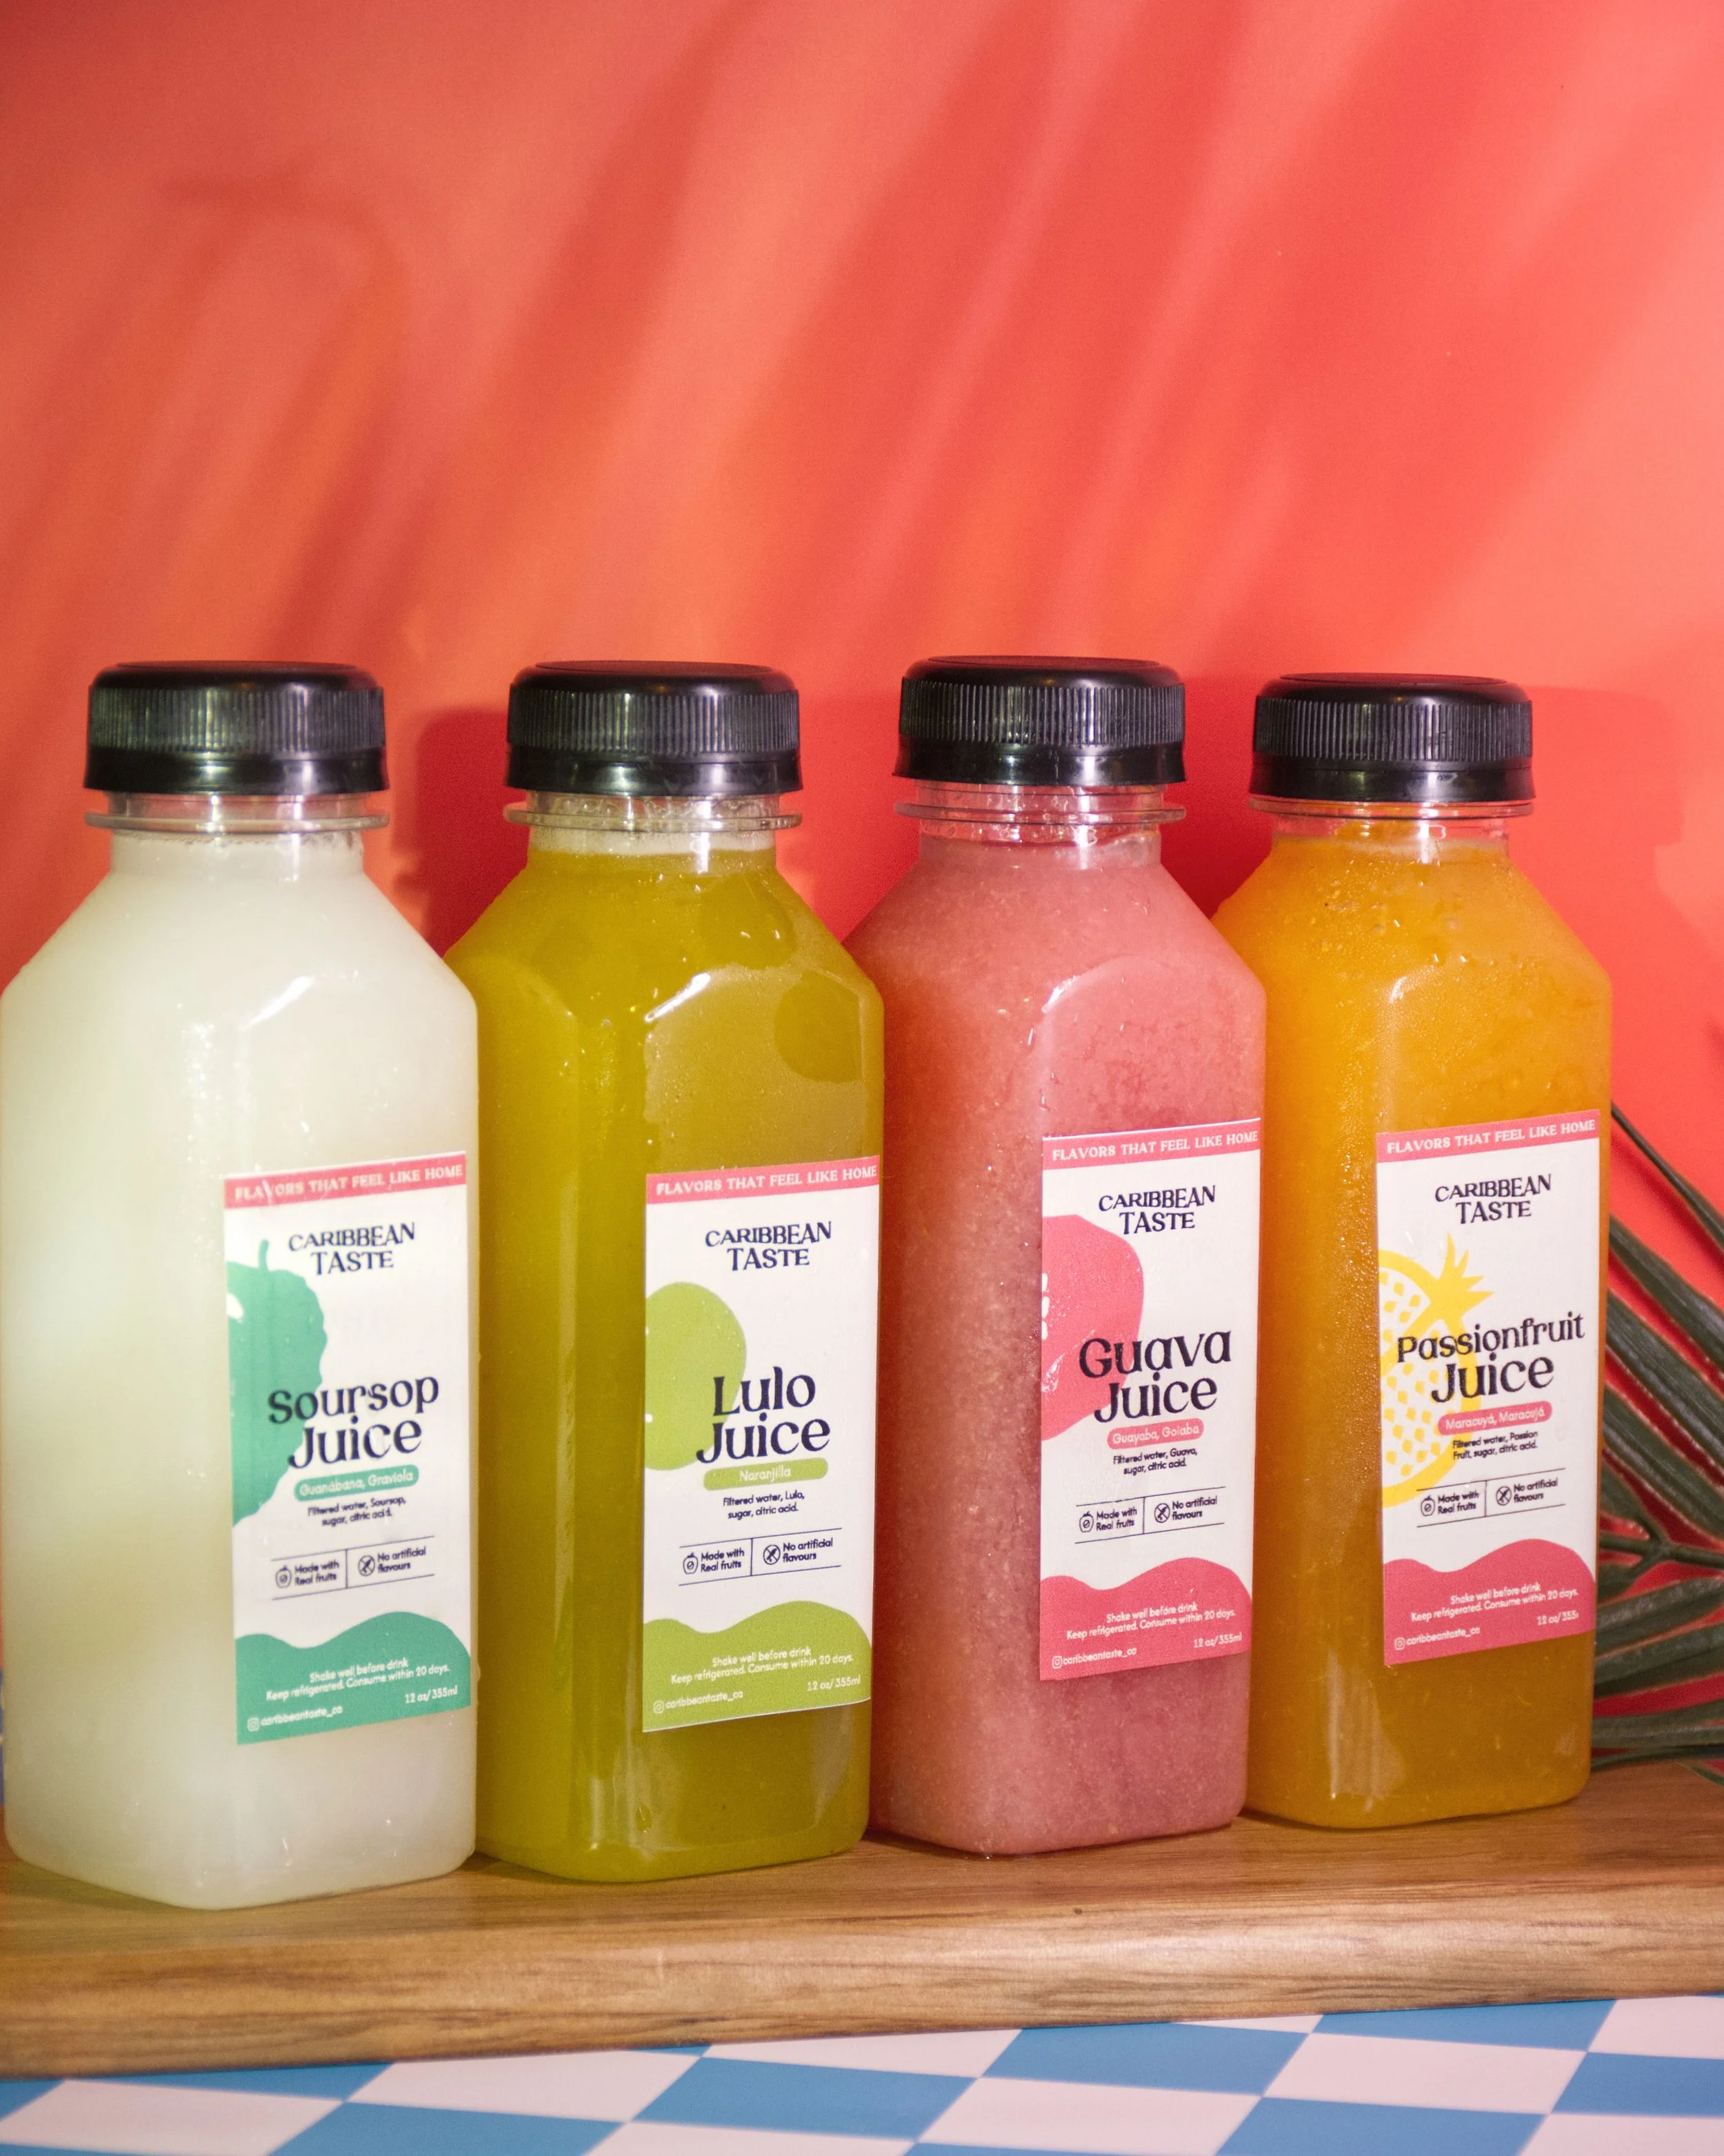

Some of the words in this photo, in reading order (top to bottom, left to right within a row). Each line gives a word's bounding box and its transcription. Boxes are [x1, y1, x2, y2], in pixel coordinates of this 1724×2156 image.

[1053, 1145, 1116, 1161] FLAVORS
[1121, 1142, 1156, 1155] THAT
[1161, 1138, 1190, 1152] FEEL
[1194, 1135, 1222, 1148] LIKE
[1226, 1130, 1259, 1145] HOME
[1387, 1137, 1451, 1153] FLAVORS
[1454, 1132, 1491, 1147] THAT
[1495, 1128, 1525, 1142] FEEL
[1530, 1125, 1557, 1138] LIKE
[1561, 1119, 1596, 1134] HOME
[234, 1181, 304, 1201] FLAVORS
[308, 1177, 348, 1193] THAT
[352, 1173, 385, 1188] FEEL
[390, 1168, 420, 1184] LIKE
[424, 1164, 463, 1180] HOME
[656, 1179, 722, 1195] FLAVORS
[727, 1175, 765, 1190] THAT
[770, 1172, 802, 1186] FEEL
[808, 1169, 838, 1184] LIKE
[843, 1165, 877, 1179] HOME
[1435, 1174, 1551, 1202] CARIBBEAN
[1099, 1185, 1216, 1211] CARIBBEAN
[1456, 1200, 1532, 1224] TASTE
[1119, 1211, 1195, 1235] TASTE
[288, 1221, 415, 1251] CARIBBEAN
[705, 1221, 832, 1247] CARIBBEAN
[311, 1250, 394, 1276] TASTE
[727, 1246, 810, 1271] TASTE
[1397, 1311, 1585, 1363] Passionfruit
[1079, 1330, 1232, 1379] Guava
[1431, 1353, 1554, 1403] Juice
[268, 1377, 439, 1424] Soursop
[713, 1366, 816, 1417] Lulo
[1094, 1372, 1217, 1423] Juice
[1445, 1416, 1496, 1430] Maracuyá,
[1499, 1406, 1545, 1423] Maracujá
[287, 1415, 422, 1469] Juice
[696, 1413, 830, 1464] Juice
[1112, 1430, 1159, 1446] Guayaba,
[1162, 1423, 1199, 1437] Goiaba
[1452, 1439, 1481, 1449] Filtered
[1483, 1435, 1508, 1444] water,
[1510, 1430, 1538, 1441] Passion
[1114, 1453, 1142, 1464] Filtered
[1144, 1450, 1168, 1461] water,
[1170, 1448, 1197, 1457] Guava,
[1453, 1451, 1472, 1459] Fruit,
[1474, 1448, 1497, 1458] sugar,
[1499, 1444, 1517, 1454] citric
[1519, 1441, 1538, 1450] acid.
[739, 1465, 791, 1482] Naranjilla
[1123, 1465, 1146, 1475] sugar,
[1148, 1461, 1166, 1471] citric
[1168, 1458, 1187, 1468] acid.
[368, 1468, 414, 1487] Graviola
[1514, 1484, 1525, 1492] No
[1527, 1478, 1558, 1490] artificial
[308, 1503, 339, 1517] Filtered
[341, 1501, 368, 1512] water,
[370, 1497, 406, 1507] Soursop,
[723, 1495, 754, 1506] Filtered
[756, 1493, 783, 1503] water,
[785, 1490, 805, 1499] Lulo,
[1172, 1501, 1184, 1510] No
[1185, 1496, 1217, 1508] artificial
[1438, 1494, 1460, 1504] Made
[1463, 1490, 1479, 1499] with
[1514, 1493, 1543, 1503] flavours
[728, 1509, 754, 1520] sugar,
[756, 1506, 776, 1516] citric
[779, 1503, 799, 1513] acid.
[1096, 1511, 1119, 1520] Made
[1122, 1507, 1137, 1517] with
[1172, 1510, 1203, 1521] flavours
[1438, 1504, 1454, 1514] Real
[1457, 1502, 1476, 1512] fruits
[322, 1515, 348, 1527] sugar,
[350, 1510, 370, 1522] citric
[1096, 1521, 1113, 1531] Real
[1116, 1519, 1134, 1528] fruits
[378, 1553, 390, 1562] No
[392, 1546, 426, 1560] artificial
[783, 1543, 795, 1551] No
[799, 1537, 833, 1550] artificial
[701, 1553, 724, 1561] Made
[727, 1548, 744, 1557] with
[783, 1552, 816, 1562] flavours
[294, 1564, 319, 1574] Made
[321, 1560, 339, 1571] with
[378, 1561, 411, 1573] flavours
[701, 1561, 719, 1572] Real
[721, 1560, 741, 1570] fruits
[294, 1575, 313, 1586] Real
[316, 1573, 337, 1584] fruits
[1451, 1595, 1474, 1604] Shake
[1476, 1591, 1492, 1600] well
[1493, 1587, 1520, 1599] before
[1521, 1582, 1541, 1593] drink
[1106, 1613, 1130, 1624] Shake
[1132, 1608, 1147, 1619] well
[1150, 1605, 1176, 1617] before
[1178, 1601, 1198, 1613] drink
[1411, 1612, 1432, 1622] Keep
[1434, 1604, 1482, 1619] refrigerated.
[1485, 1598, 1521, 1610] Consume
[1522, 1594, 1545, 1605] within
[1547, 1590, 1558, 1601] 20
[1559, 1588, 1579, 1599] days.
[1066, 1630, 1087, 1641] Keep
[1090, 1621, 1138, 1637] refrigerated.
[1140, 1617, 1177, 1629] Consume
[1179, 1613, 1203, 1625] within
[1204, 1611, 1215, 1621] 20
[1216, 1608, 1236, 1620] days.
[1537, 1615, 1547, 1625] 12
[1194, 1638, 1203, 1648] 12
[712, 1657, 736, 1667] Shake
[739, 1653, 756, 1663] well
[759, 1650, 788, 1661] before
[789, 1646, 811, 1656] drink
[310, 1671, 336, 1684] Shake
[338, 1668, 354, 1678] well
[356, 1662, 385, 1675] before
[387, 1657, 409, 1670] drink
[671, 1673, 692, 1685] Keep
[748, 1661, 788, 1673] Consume
[791, 1657, 816, 1668] within
[819, 1655, 830, 1665] 20
[832, 1652, 854, 1665] days.
[266, 1689, 289, 1701] Keep
[291, 1679, 344, 1698] refrigerated.
[346, 1673, 386, 1688] Consume
[388, 1669, 414, 1681] within
[416, 1666, 427, 1677] 20
[808, 1681, 818, 1691] 12
[405, 1693, 415, 1704] 12
